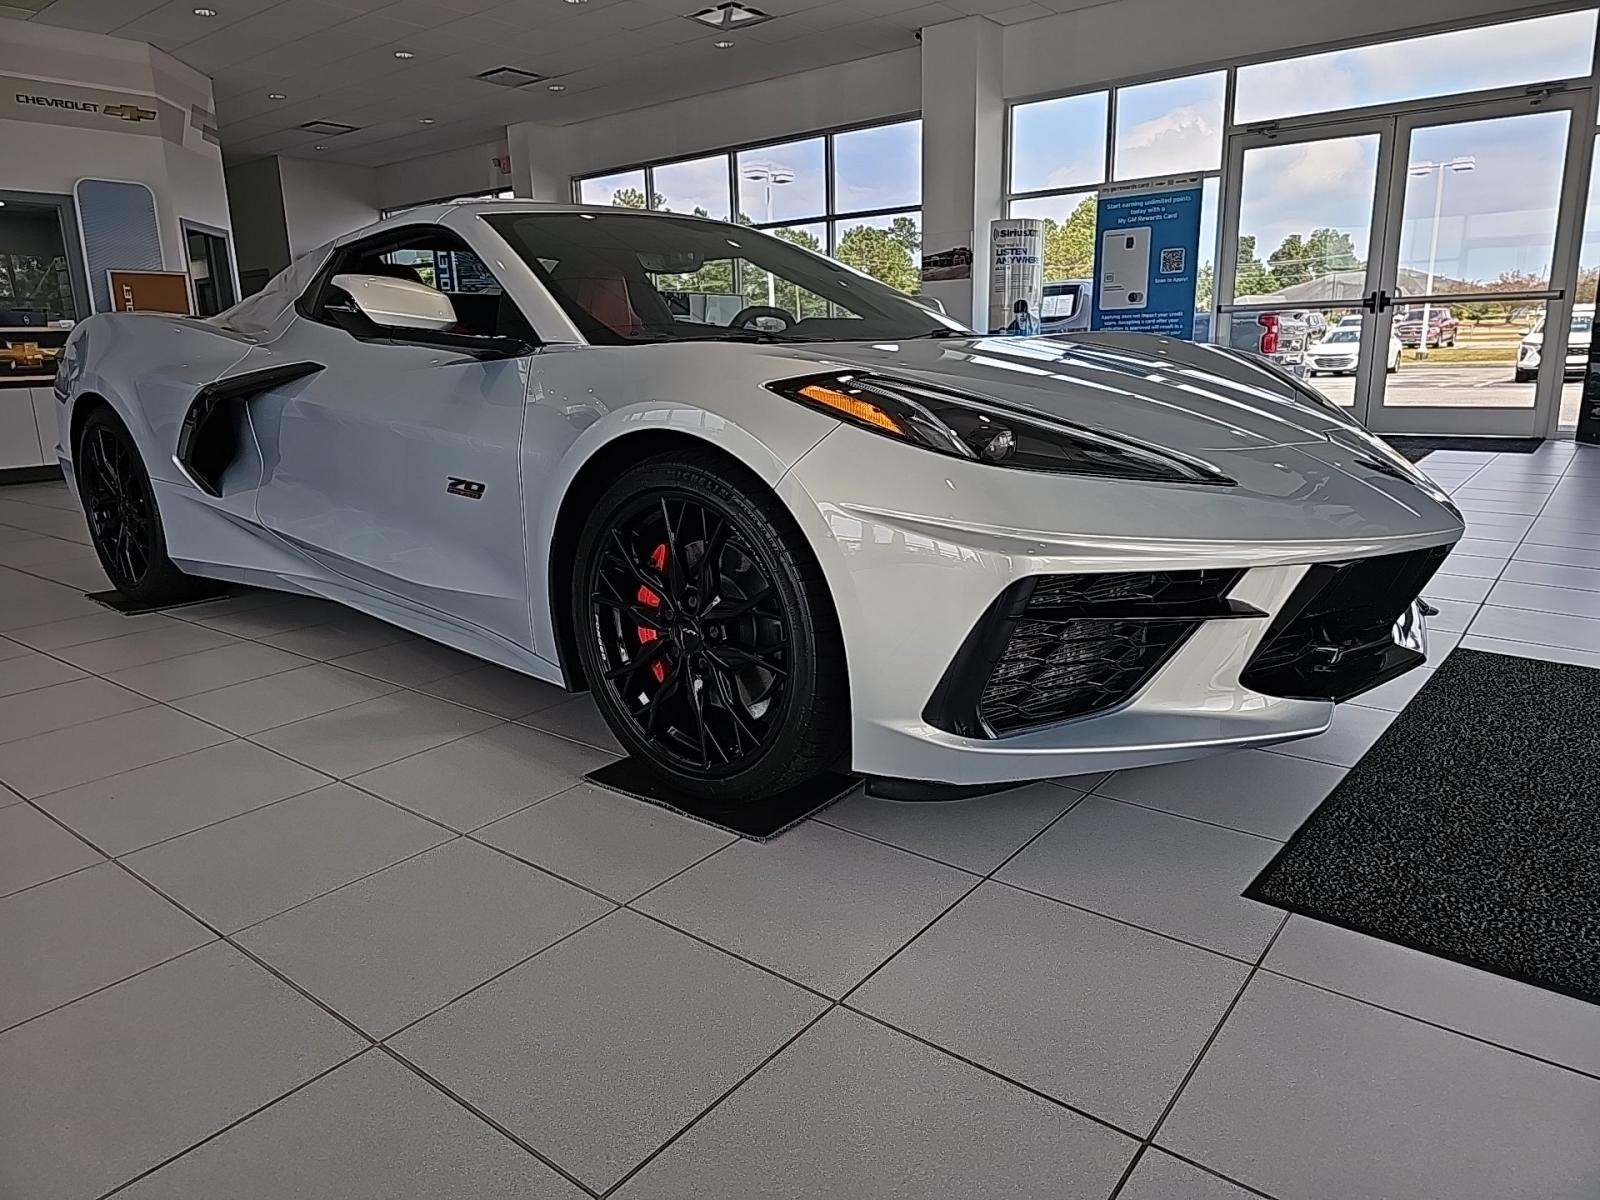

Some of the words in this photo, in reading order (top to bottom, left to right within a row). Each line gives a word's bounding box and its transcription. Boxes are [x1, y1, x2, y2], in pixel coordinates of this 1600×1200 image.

[16, 94, 99, 113] CHEVROLET
[1144, 197, 1172, 205] unlimited
[996, 248, 1028, 256] LISTEN
